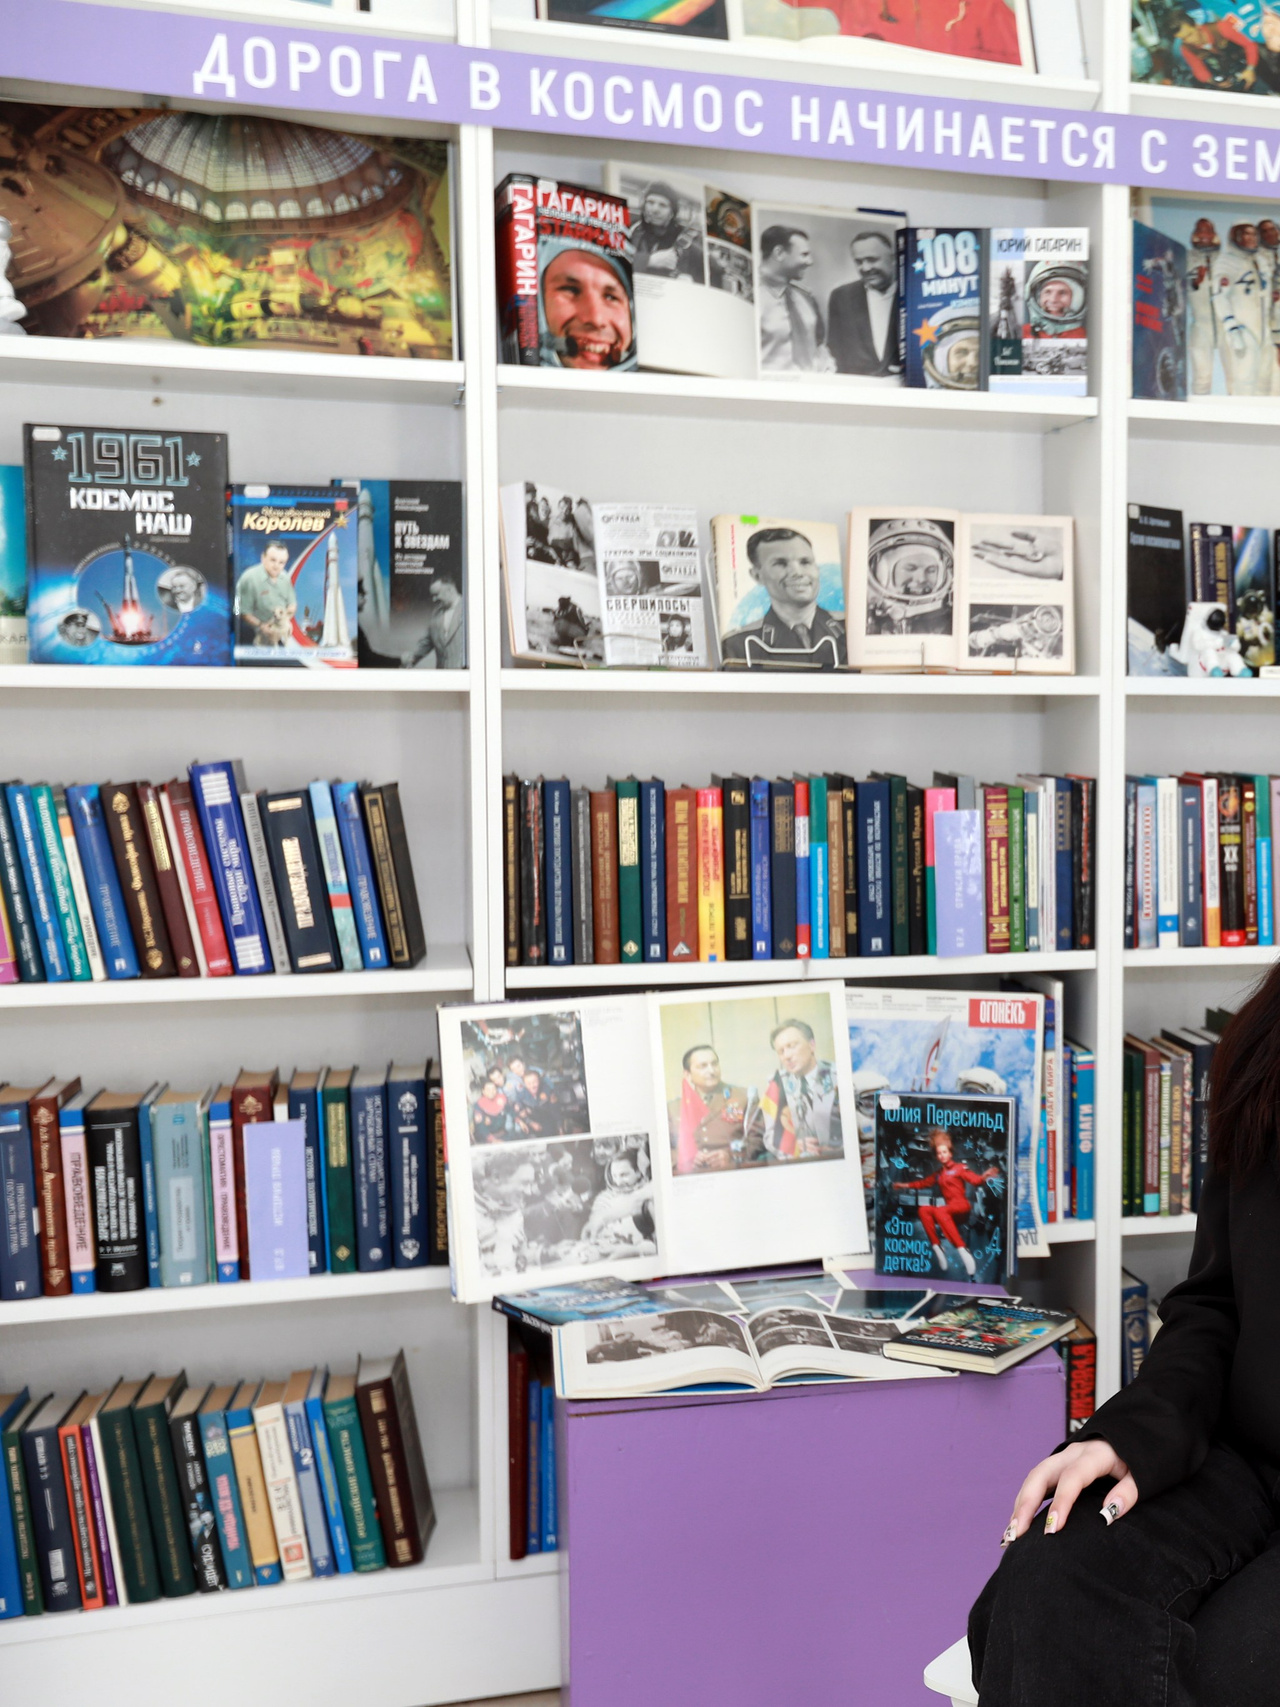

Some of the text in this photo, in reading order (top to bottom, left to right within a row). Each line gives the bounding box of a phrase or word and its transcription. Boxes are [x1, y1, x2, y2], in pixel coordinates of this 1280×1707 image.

[192, 32, 439, 105] ДОРОГА
[469, 61, 502, 112] В
[529, 66, 765, 138] КОСМОС
[790, 95, 1117, 170] НАЧИНАЕТСЯ
[1140, 128, 1168, 175] С
[536, 186, 624, 226] ГАГАРИН
[513, 184, 537, 296] ГАГАРИН
[917, 230, 979, 281] 108
[997, 237, 1082, 253] ЮРИЙ ГАГАРИН
[66, 431, 190, 487] 1961
[69, 487, 175, 513] КОСМОС
[135, 512, 193, 536] НАШ
[1046, 1057, 1055, 1127] ФЛАГИ МИРА
[884, 1103, 1005, 1133] Юлия Пересильд
[1078, 1104, 1093, 1154] ФЛАГИ
[70, 1152, 88, 1252] ПРАВОВЕДЕНИЕ
[883, 1215, 914, 1238] «Это
[882, 1253, 932, 1273] детка!»
[883, 1236, 933, 1259] космос,
[1001, 1303, 1068, 1318] АЛЮТ-7»
